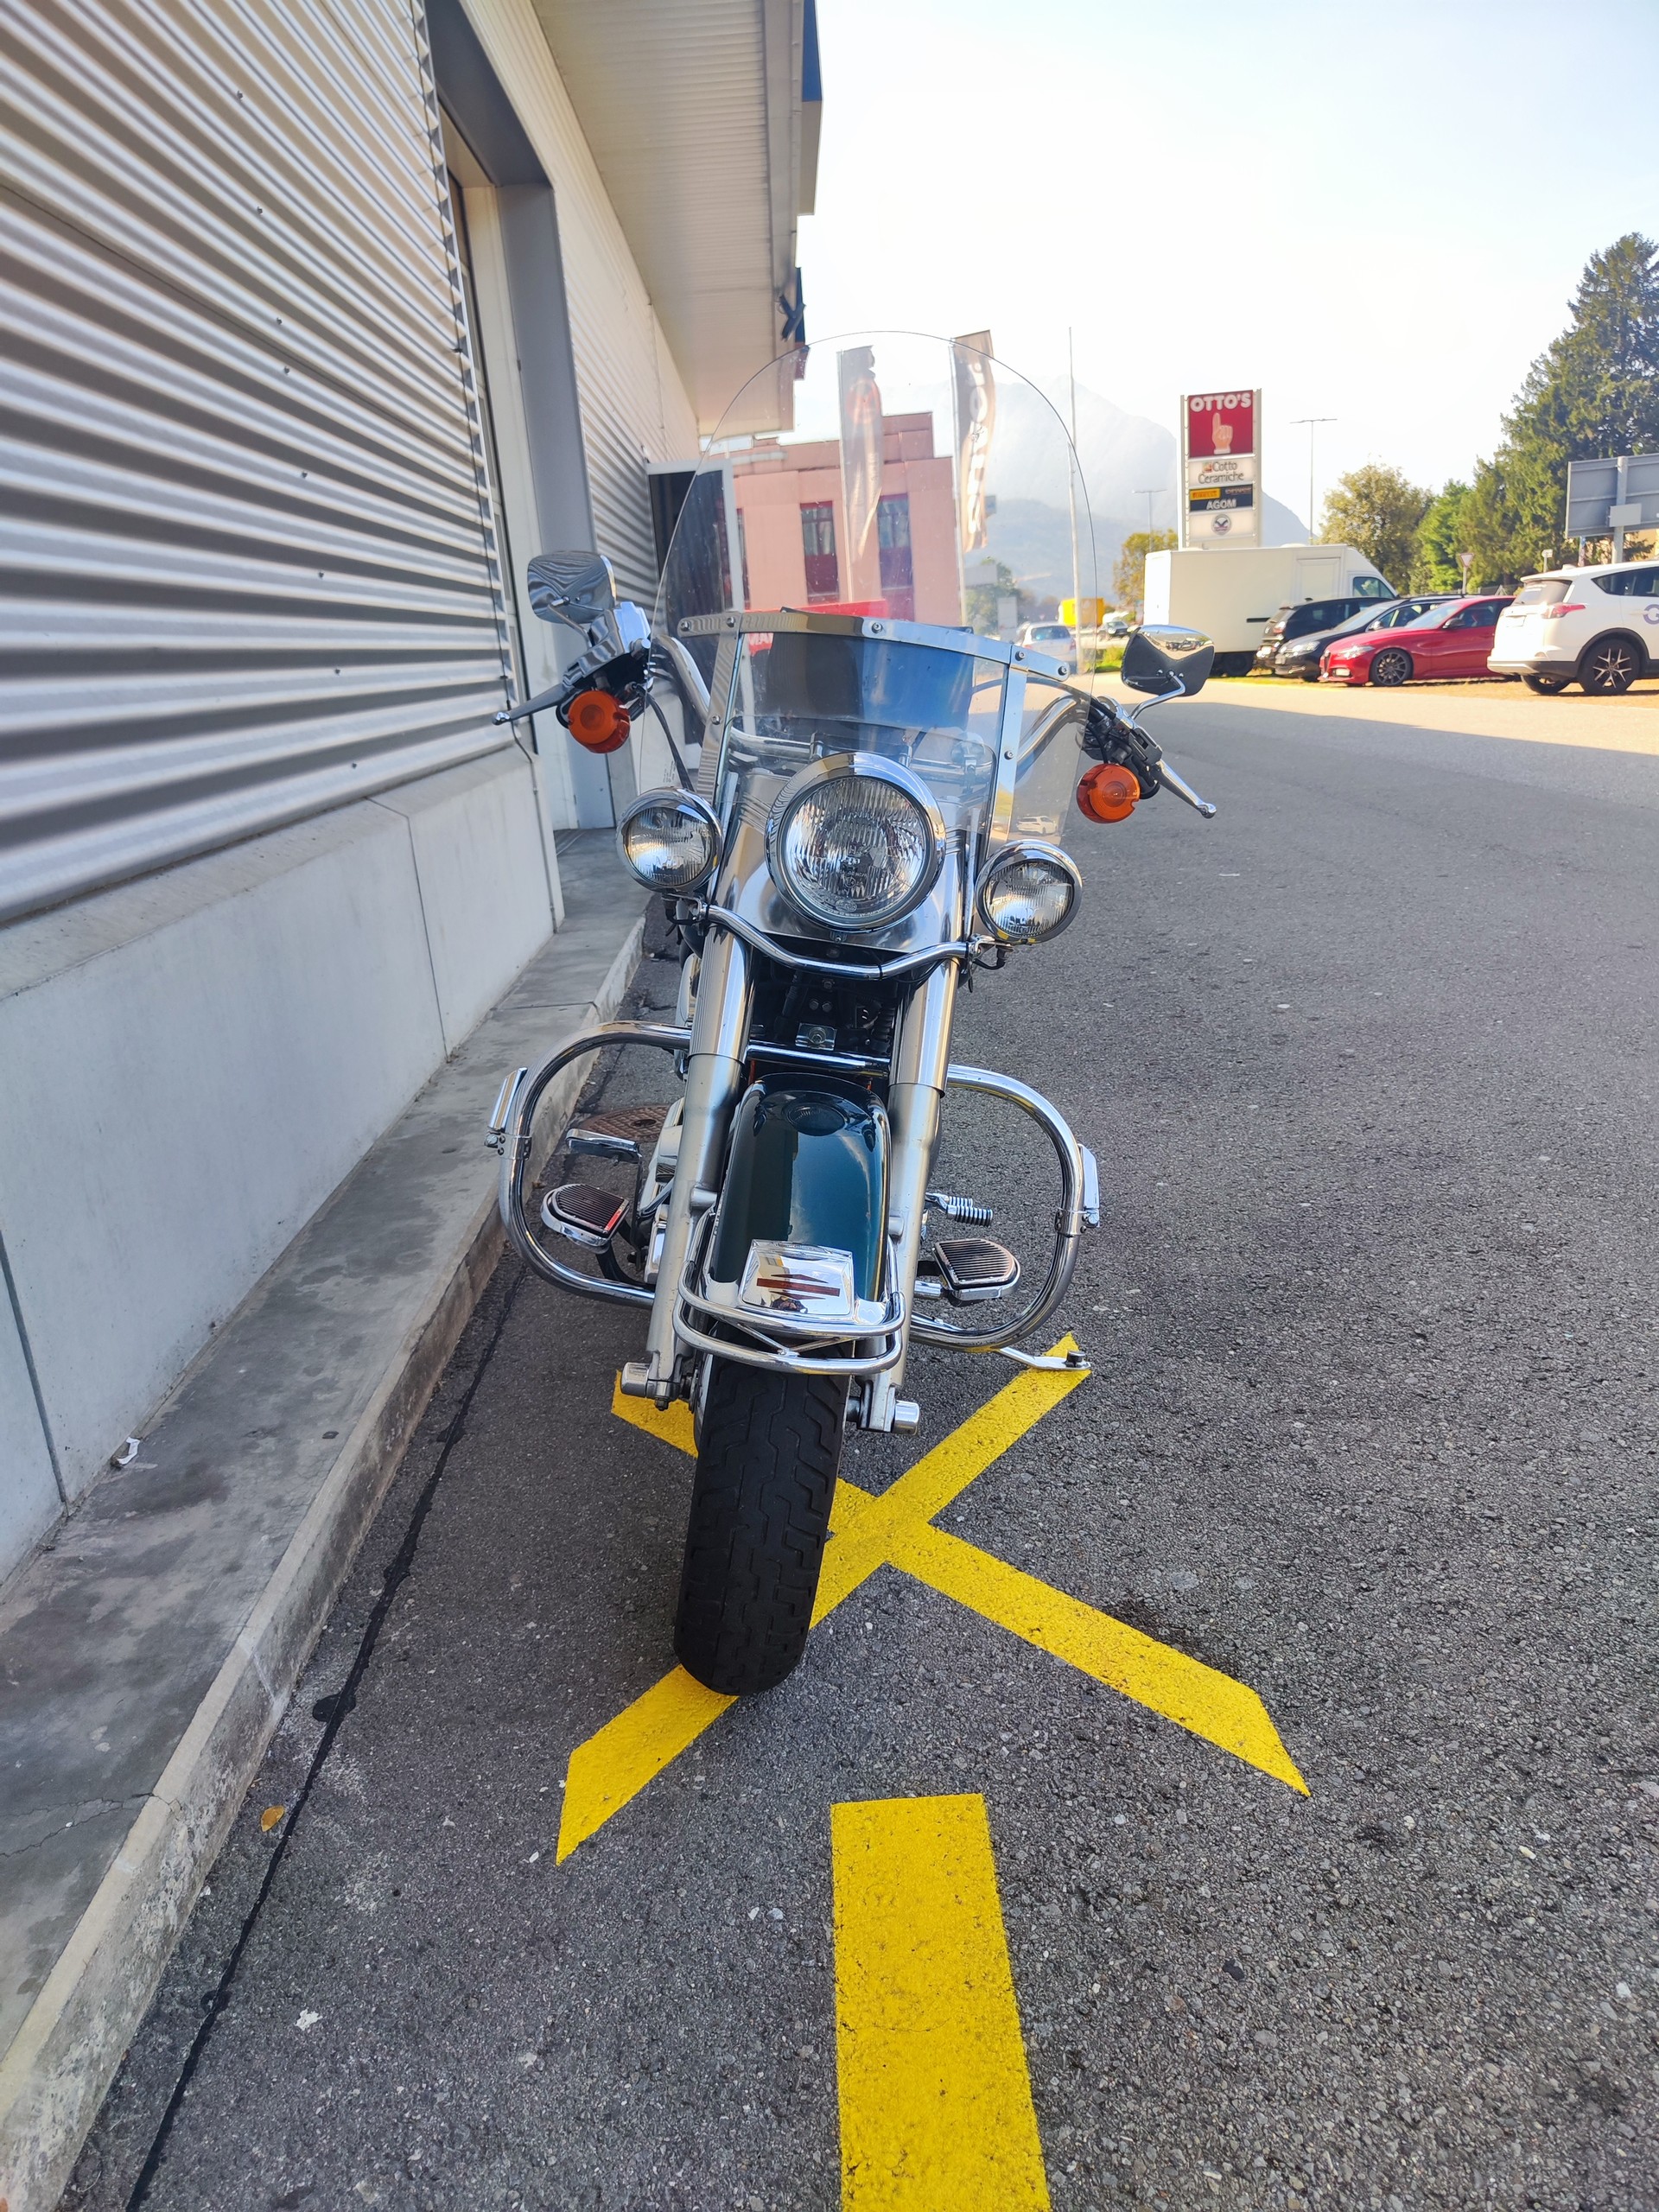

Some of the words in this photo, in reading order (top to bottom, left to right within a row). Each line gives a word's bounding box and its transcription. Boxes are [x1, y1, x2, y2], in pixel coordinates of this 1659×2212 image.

[1190, 392, 1251, 412] OTTO'S
[1212, 461, 1237, 472] Cotto
[1198, 471, 1244, 485] Ceramiche
[1205, 498, 1236, 511] AGOM
